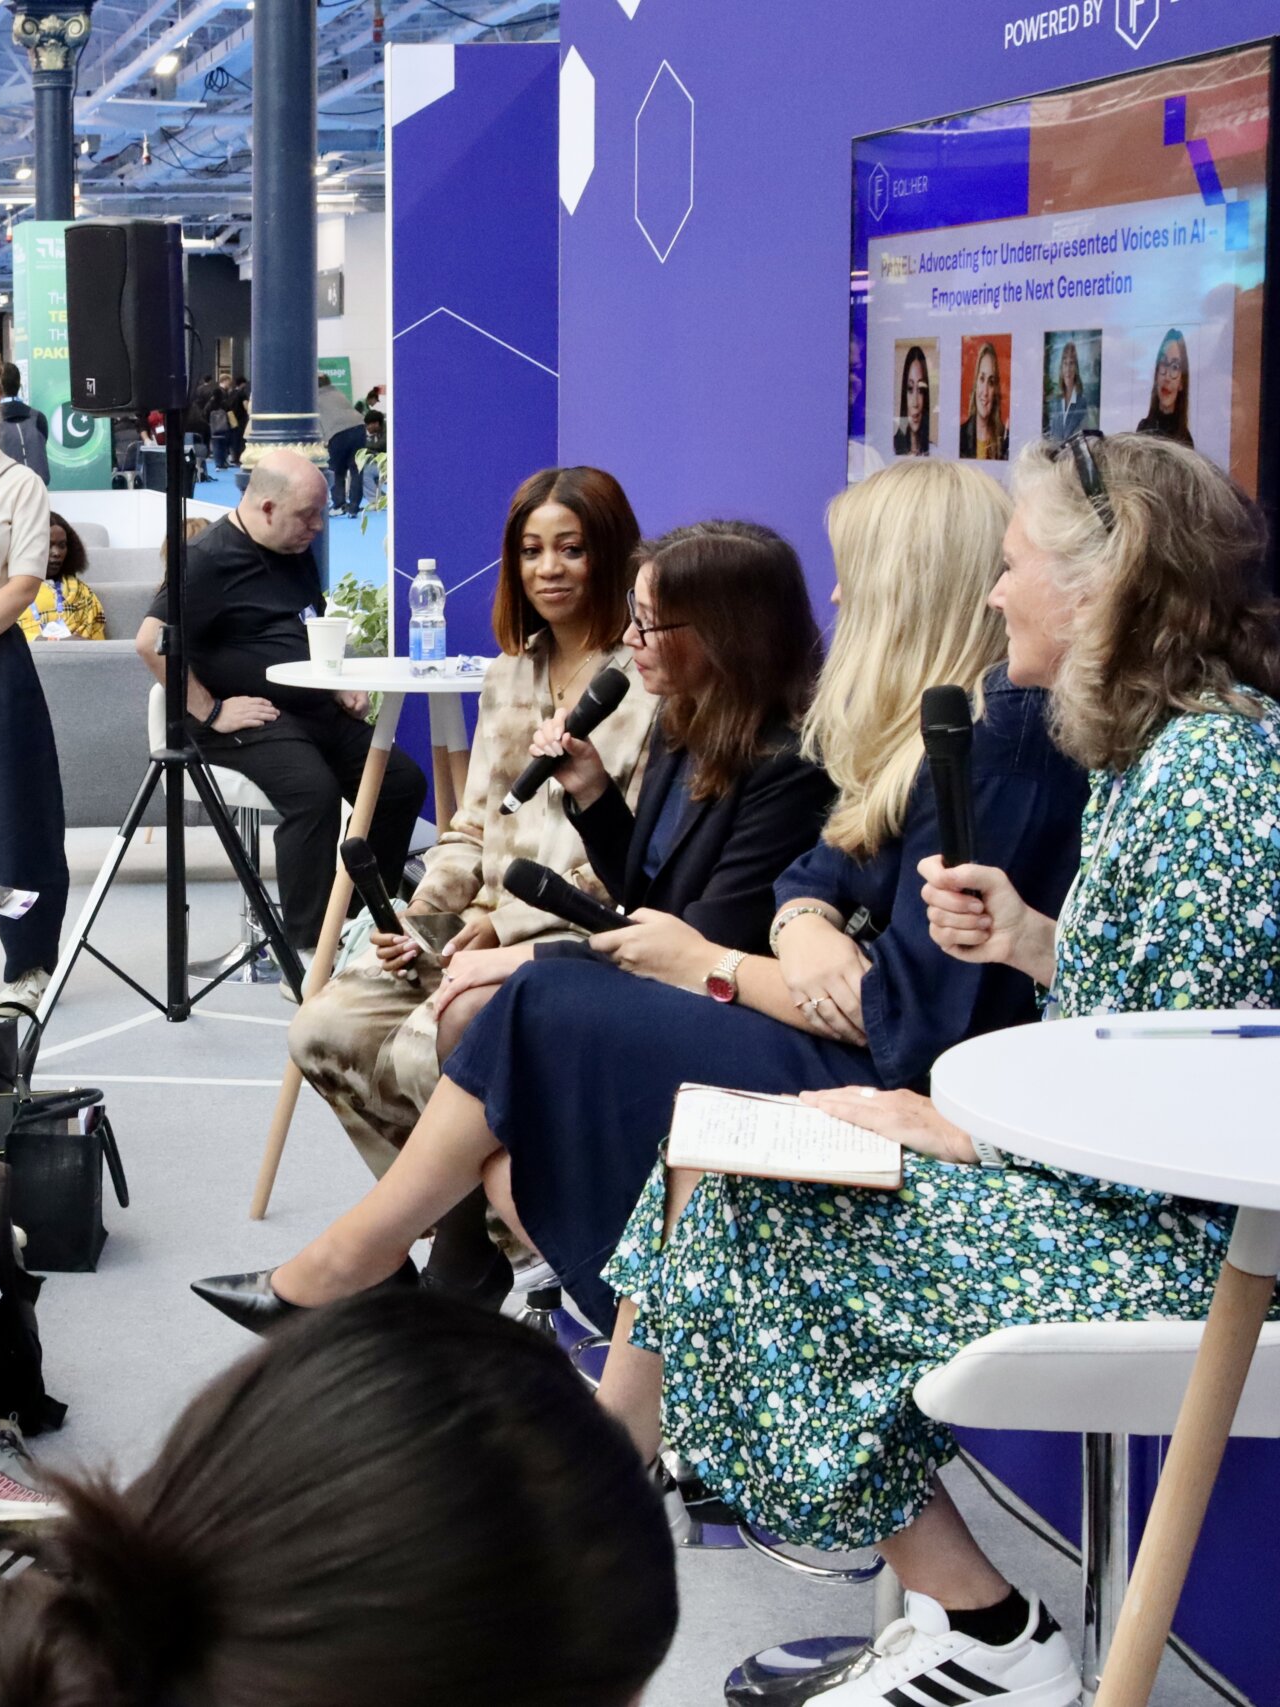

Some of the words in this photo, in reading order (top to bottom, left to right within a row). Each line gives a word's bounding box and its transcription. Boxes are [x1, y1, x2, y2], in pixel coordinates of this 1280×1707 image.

[1004, 4, 1079, 50] POWERED
[1083, 0, 1104, 28] BY
[919, 247, 980, 274] Advocating
[981, 244, 998, 268] for
[1000, 228, 1118, 265] Underrepresented
[1121, 224, 1169, 252] Voices
[1173, 221, 1187, 246] in
[1190, 217, 1206, 244] AI
[932, 281, 1001, 311] Empowering
[1002, 284, 1022, 303] the
[1025, 279, 1054, 301] Next
[1057, 271, 1133, 299] Generation
